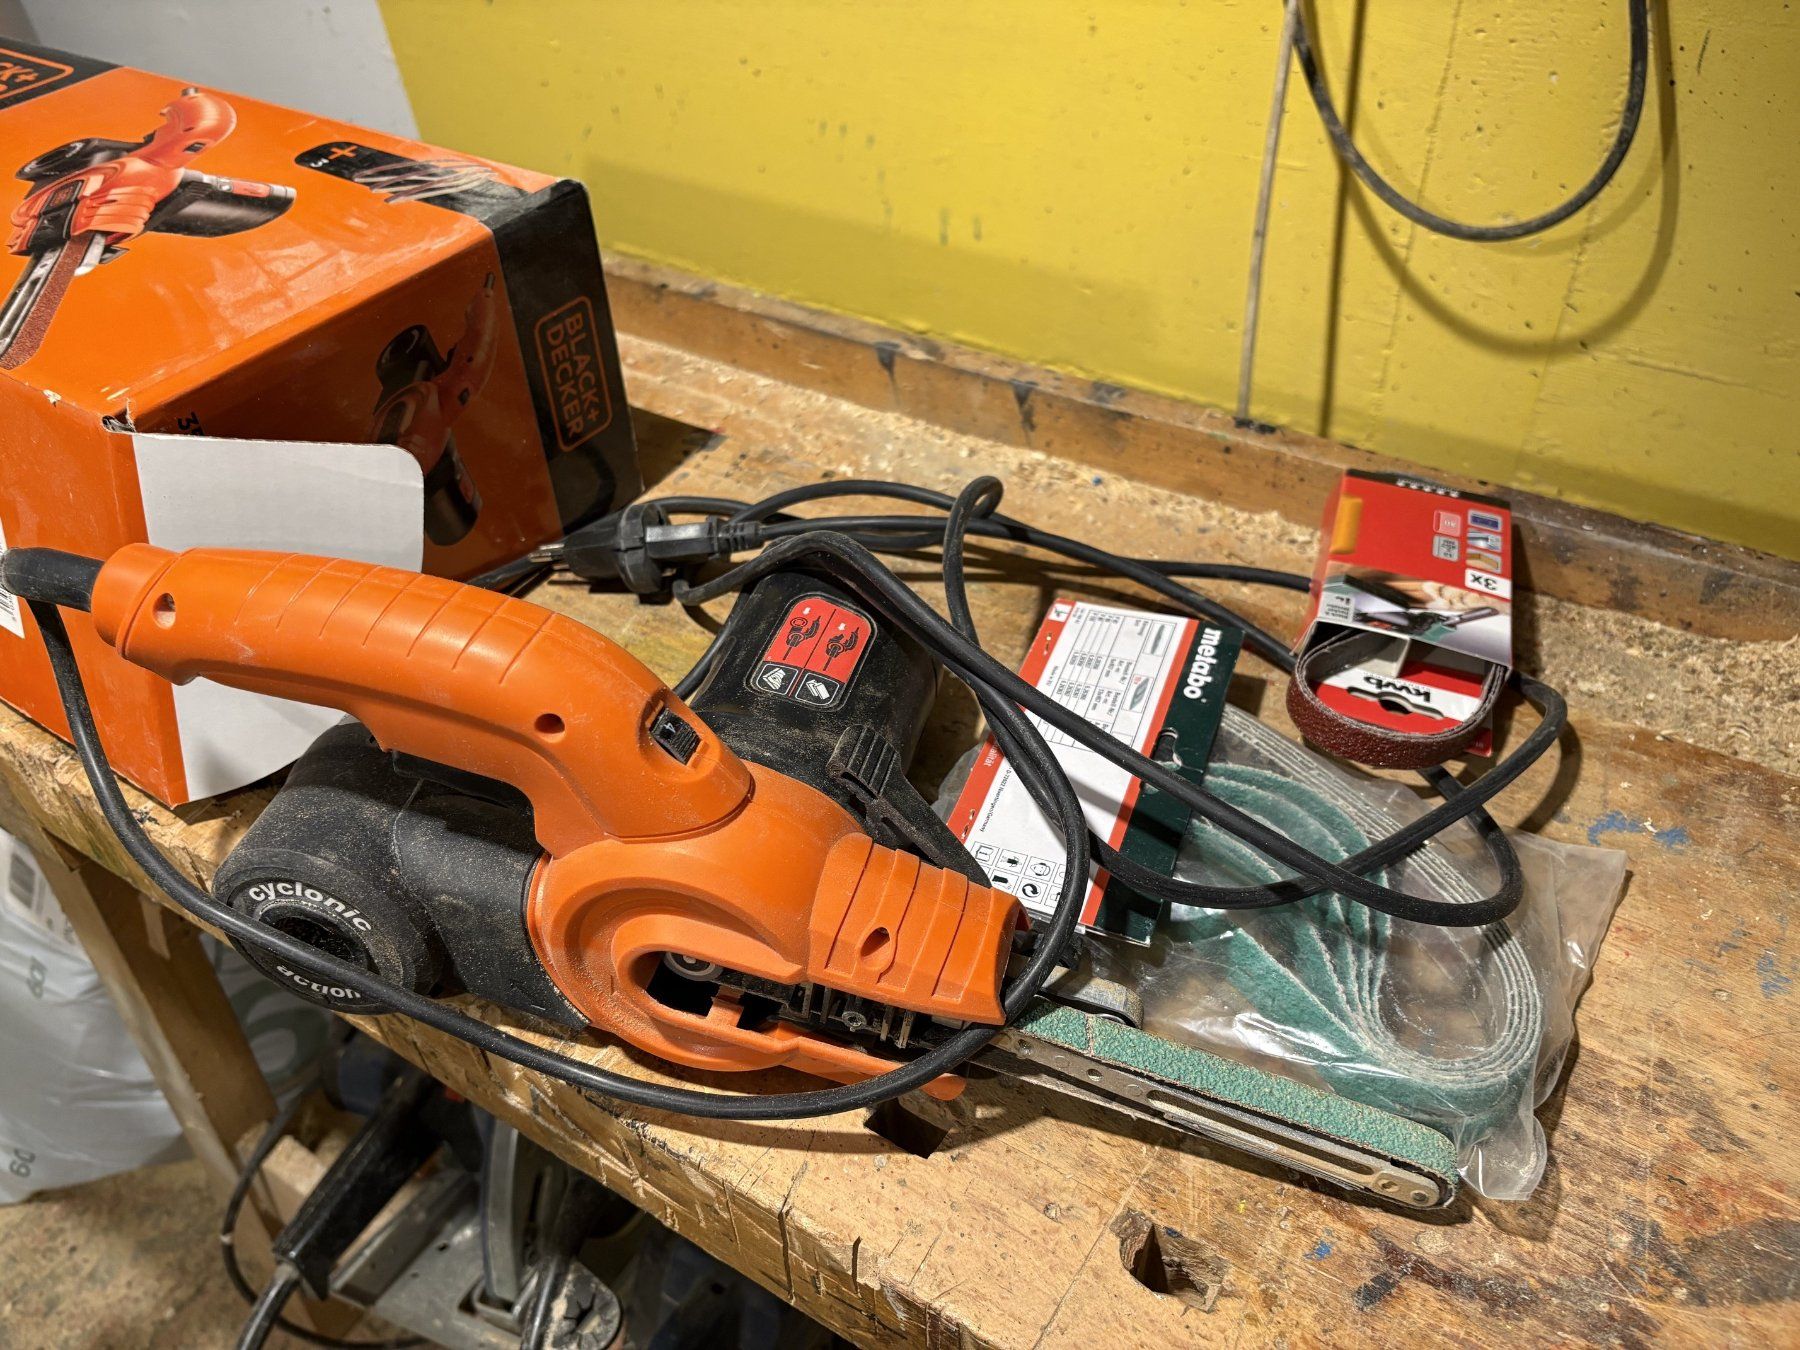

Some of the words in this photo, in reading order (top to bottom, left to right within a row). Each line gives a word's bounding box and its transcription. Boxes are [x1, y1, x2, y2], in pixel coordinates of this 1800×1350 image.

[546, 324, 585, 438] DECKER
[564, 312, 600, 422] BLACK+
[1471, 572, 1498, 591] 3x
[1183, 627, 1222, 699] metabo
[1363, 676, 1431, 703] kwb
[984, 743, 999, 767] ualität
[249, 882, 372, 931] cyclonic
[276, 965, 362, 999] action
